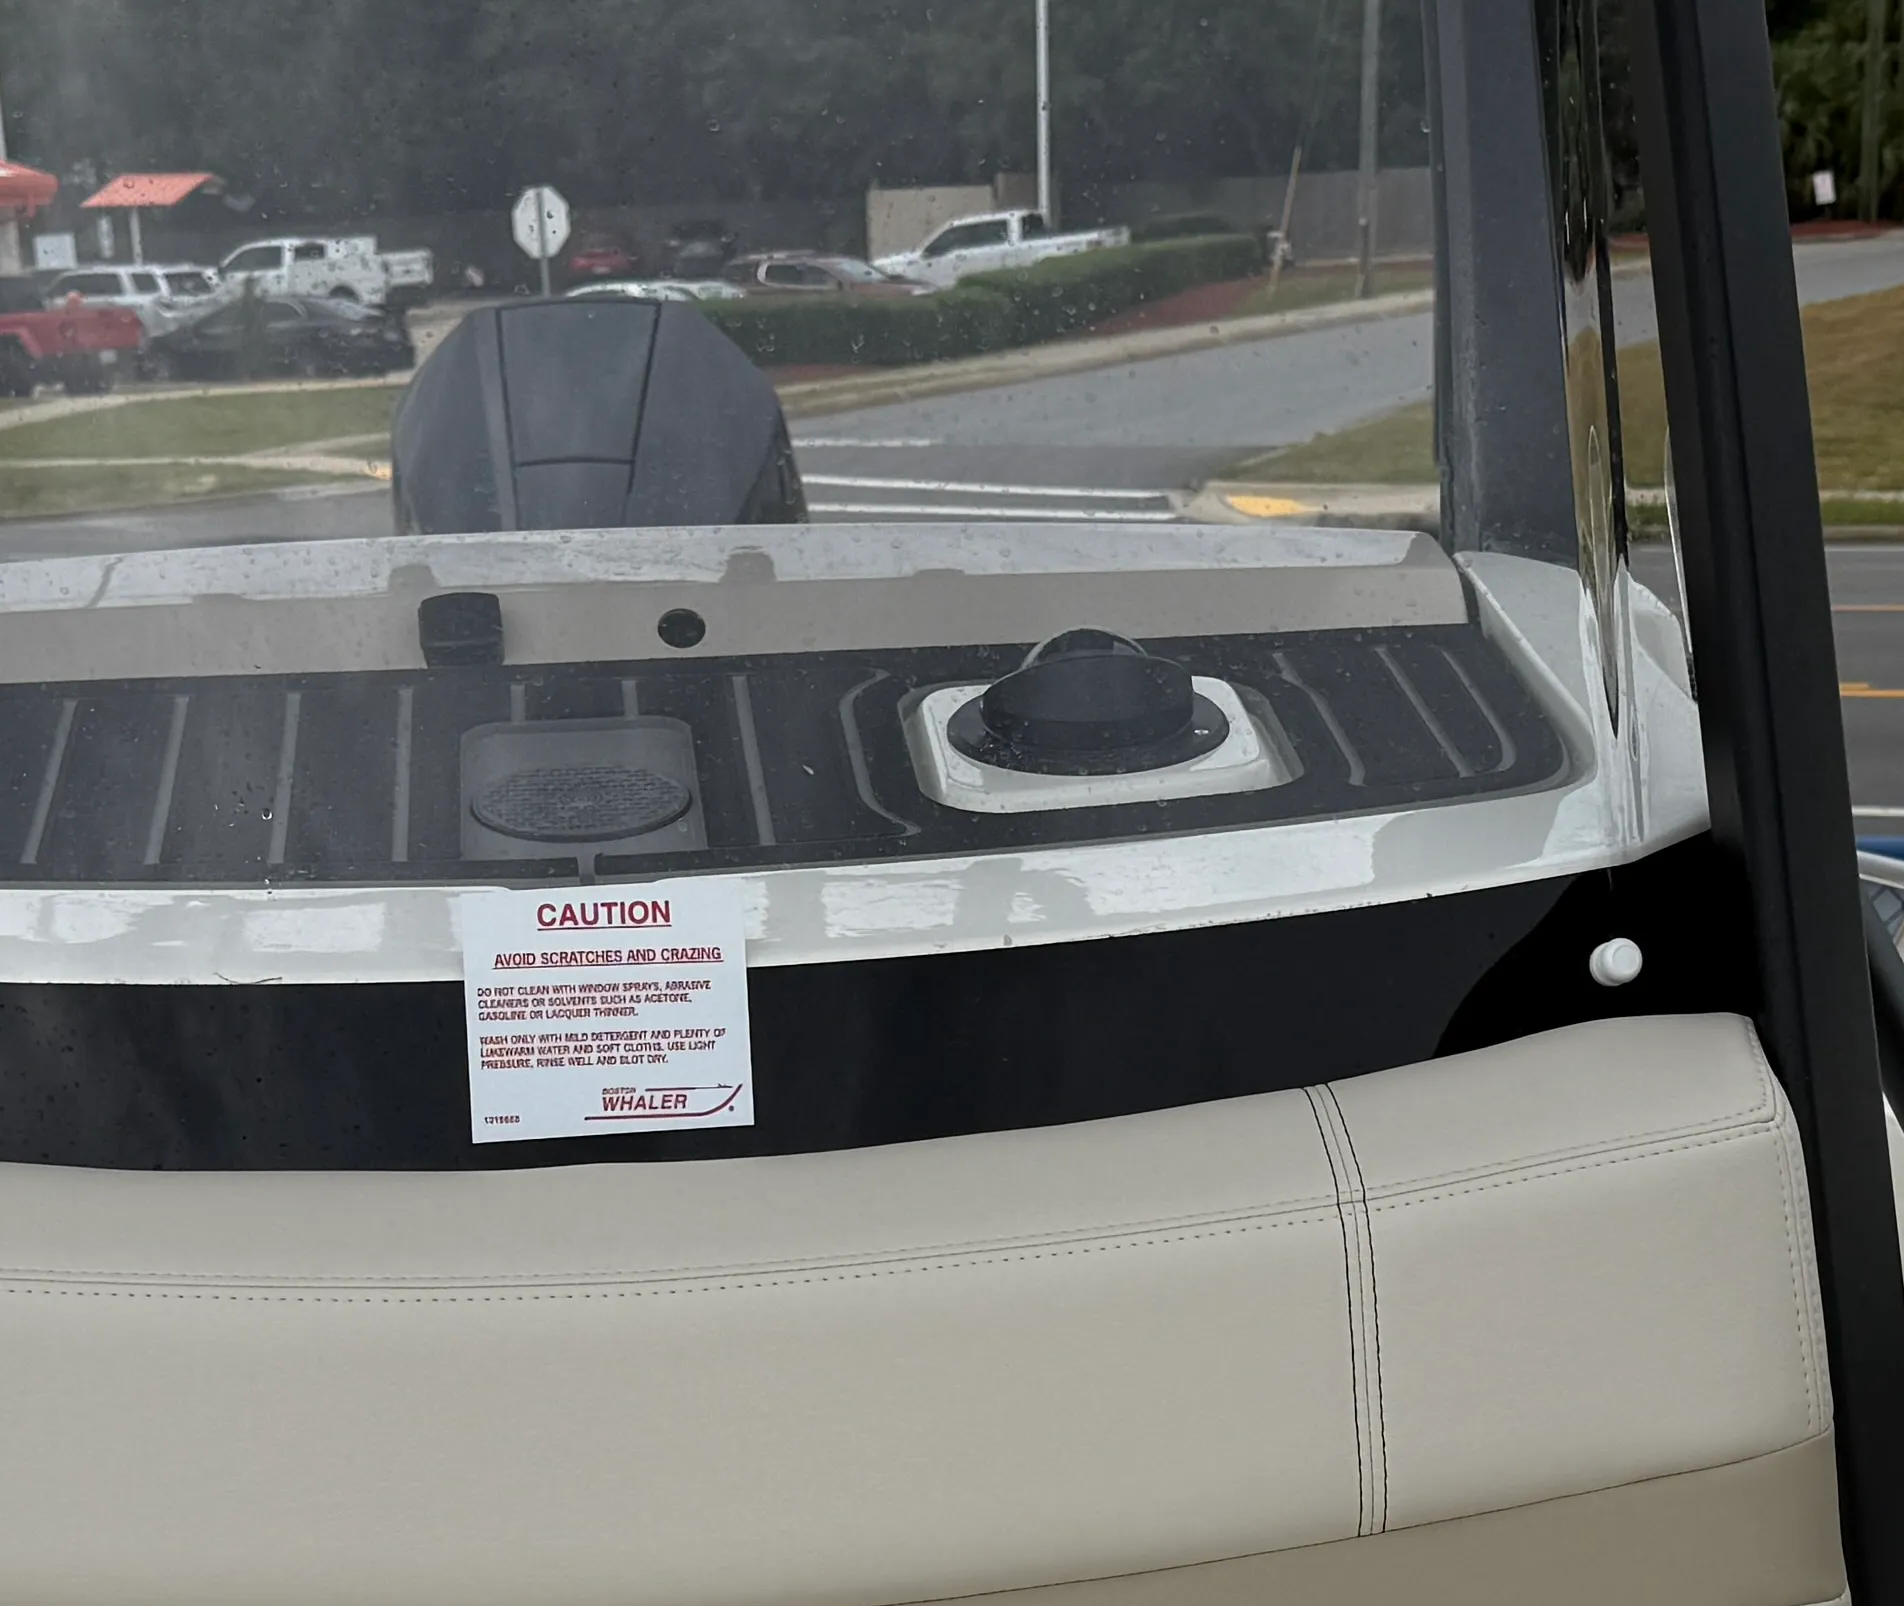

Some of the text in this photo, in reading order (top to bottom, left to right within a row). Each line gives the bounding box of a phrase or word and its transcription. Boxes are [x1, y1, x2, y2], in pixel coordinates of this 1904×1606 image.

[537, 900, 671, 927] CAUTION
[494, 946, 722, 967] AVOID SCRATCHES AND CRAZING
[477, 980, 711, 997] DO NOT CLEAN WITH WINDOW SPRAYS, ABRASIVE
[478, 998, 529, 1009] CLEANERS
[532, 998, 545, 1007] OR
[549, 996, 597, 1006] SOLVENTS
[600, 994, 626, 1005] SUCH
[629, 994, 641, 1003] AS
[479, 1010, 527, 1021] GASOLINE
[530, 1010, 543, 1020] OR
[546, 1008, 590, 1020] LACQUER
[480, 1028, 726, 1046] WASH ONLY WITH MILD DETERGENT AND PLENTY OF
[480, 1047, 534, 1057] LUKEWARM
[537, 1046, 570, 1055] WATER
[573, 1045, 593, 1054] AND
[596, 1044, 620, 1053] SOFT
[668, 1041, 686, 1051] USE
[689, 1040, 716, 1050] LIGHT
[537, 1057, 565, 1067] RINSE
[568, 1056, 594, 1066] WELL
[597, 1056, 616, 1065] AND
[620, 1055, 645, 1065] BLOT
[647, 1054, 668, 1063] DRY.
[602, 1094, 687, 1111] WHALER
